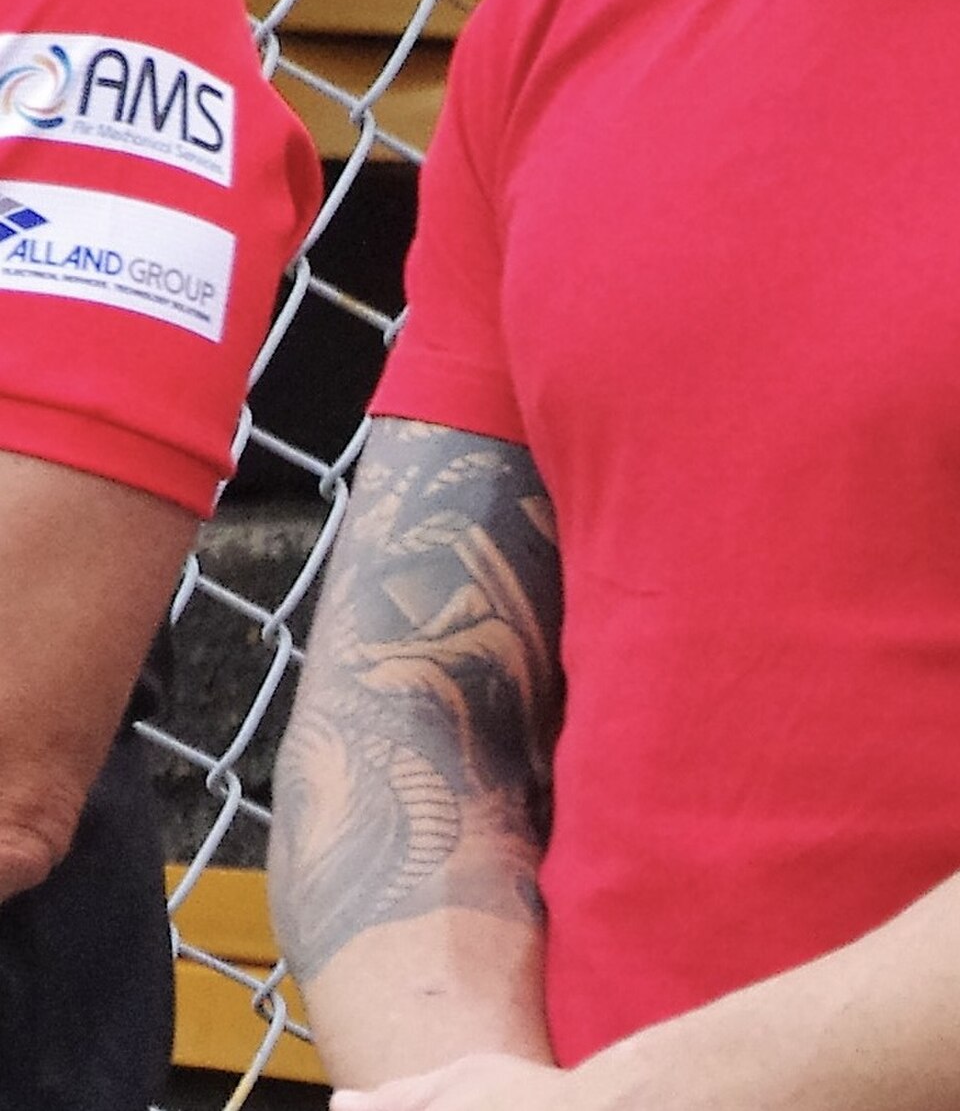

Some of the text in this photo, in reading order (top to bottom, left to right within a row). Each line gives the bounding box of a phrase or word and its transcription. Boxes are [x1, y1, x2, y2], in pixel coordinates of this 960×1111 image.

[78, 48, 224, 153] AMS
[6, 239, 215, 306] ALLAND GROUP
